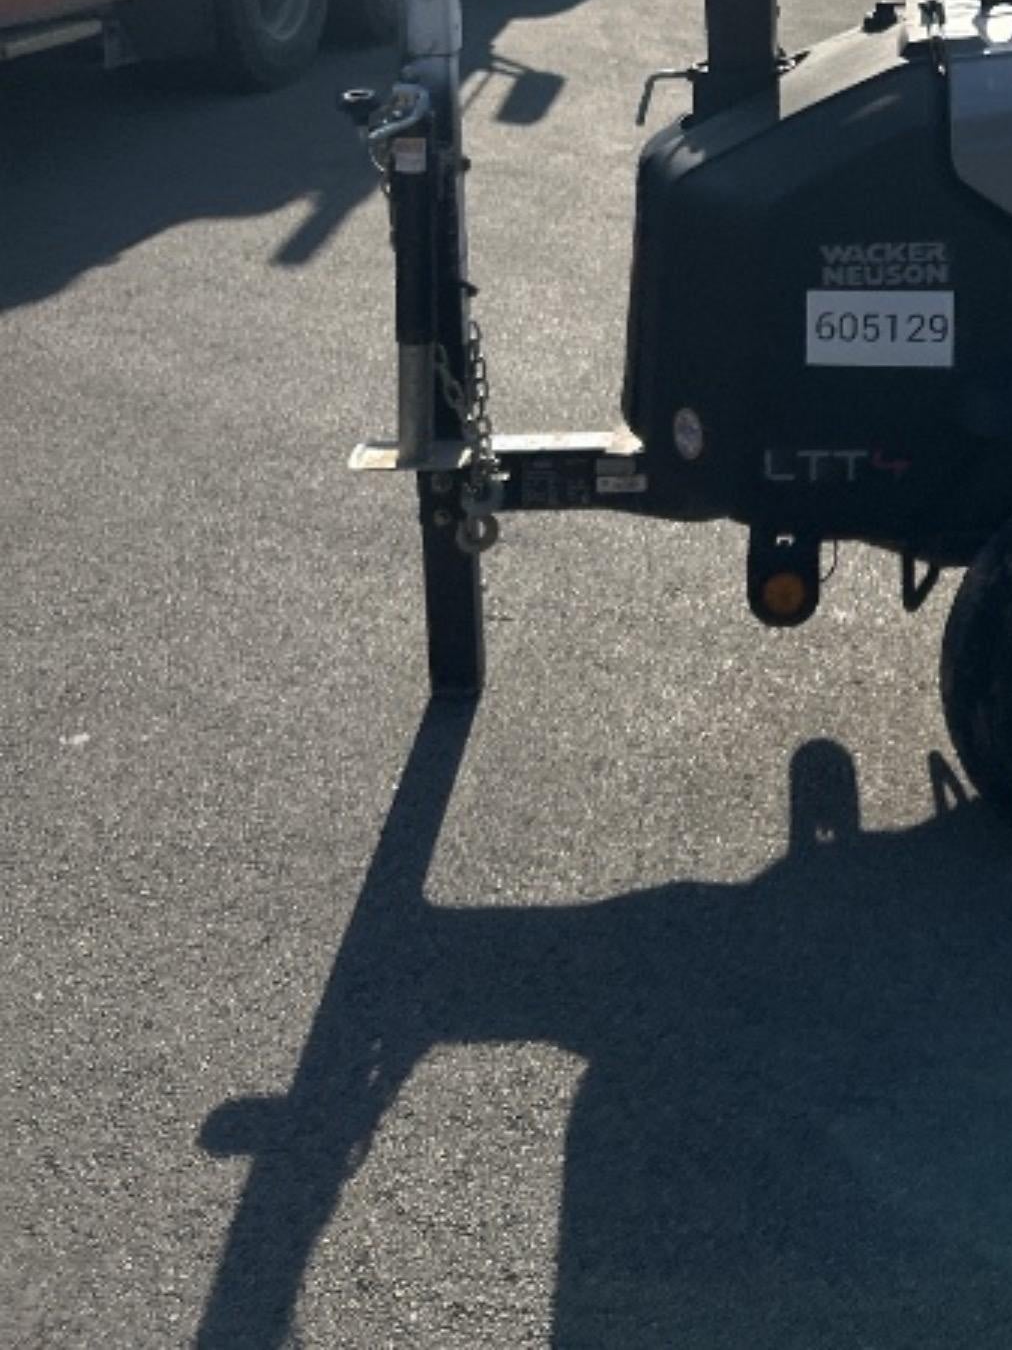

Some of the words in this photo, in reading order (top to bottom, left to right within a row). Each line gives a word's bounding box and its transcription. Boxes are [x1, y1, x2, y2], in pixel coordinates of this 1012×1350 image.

[820, 241, 947, 264] WACKER
[822, 264, 949, 286] NEUSON
[815, 311, 950, 344] 605129
